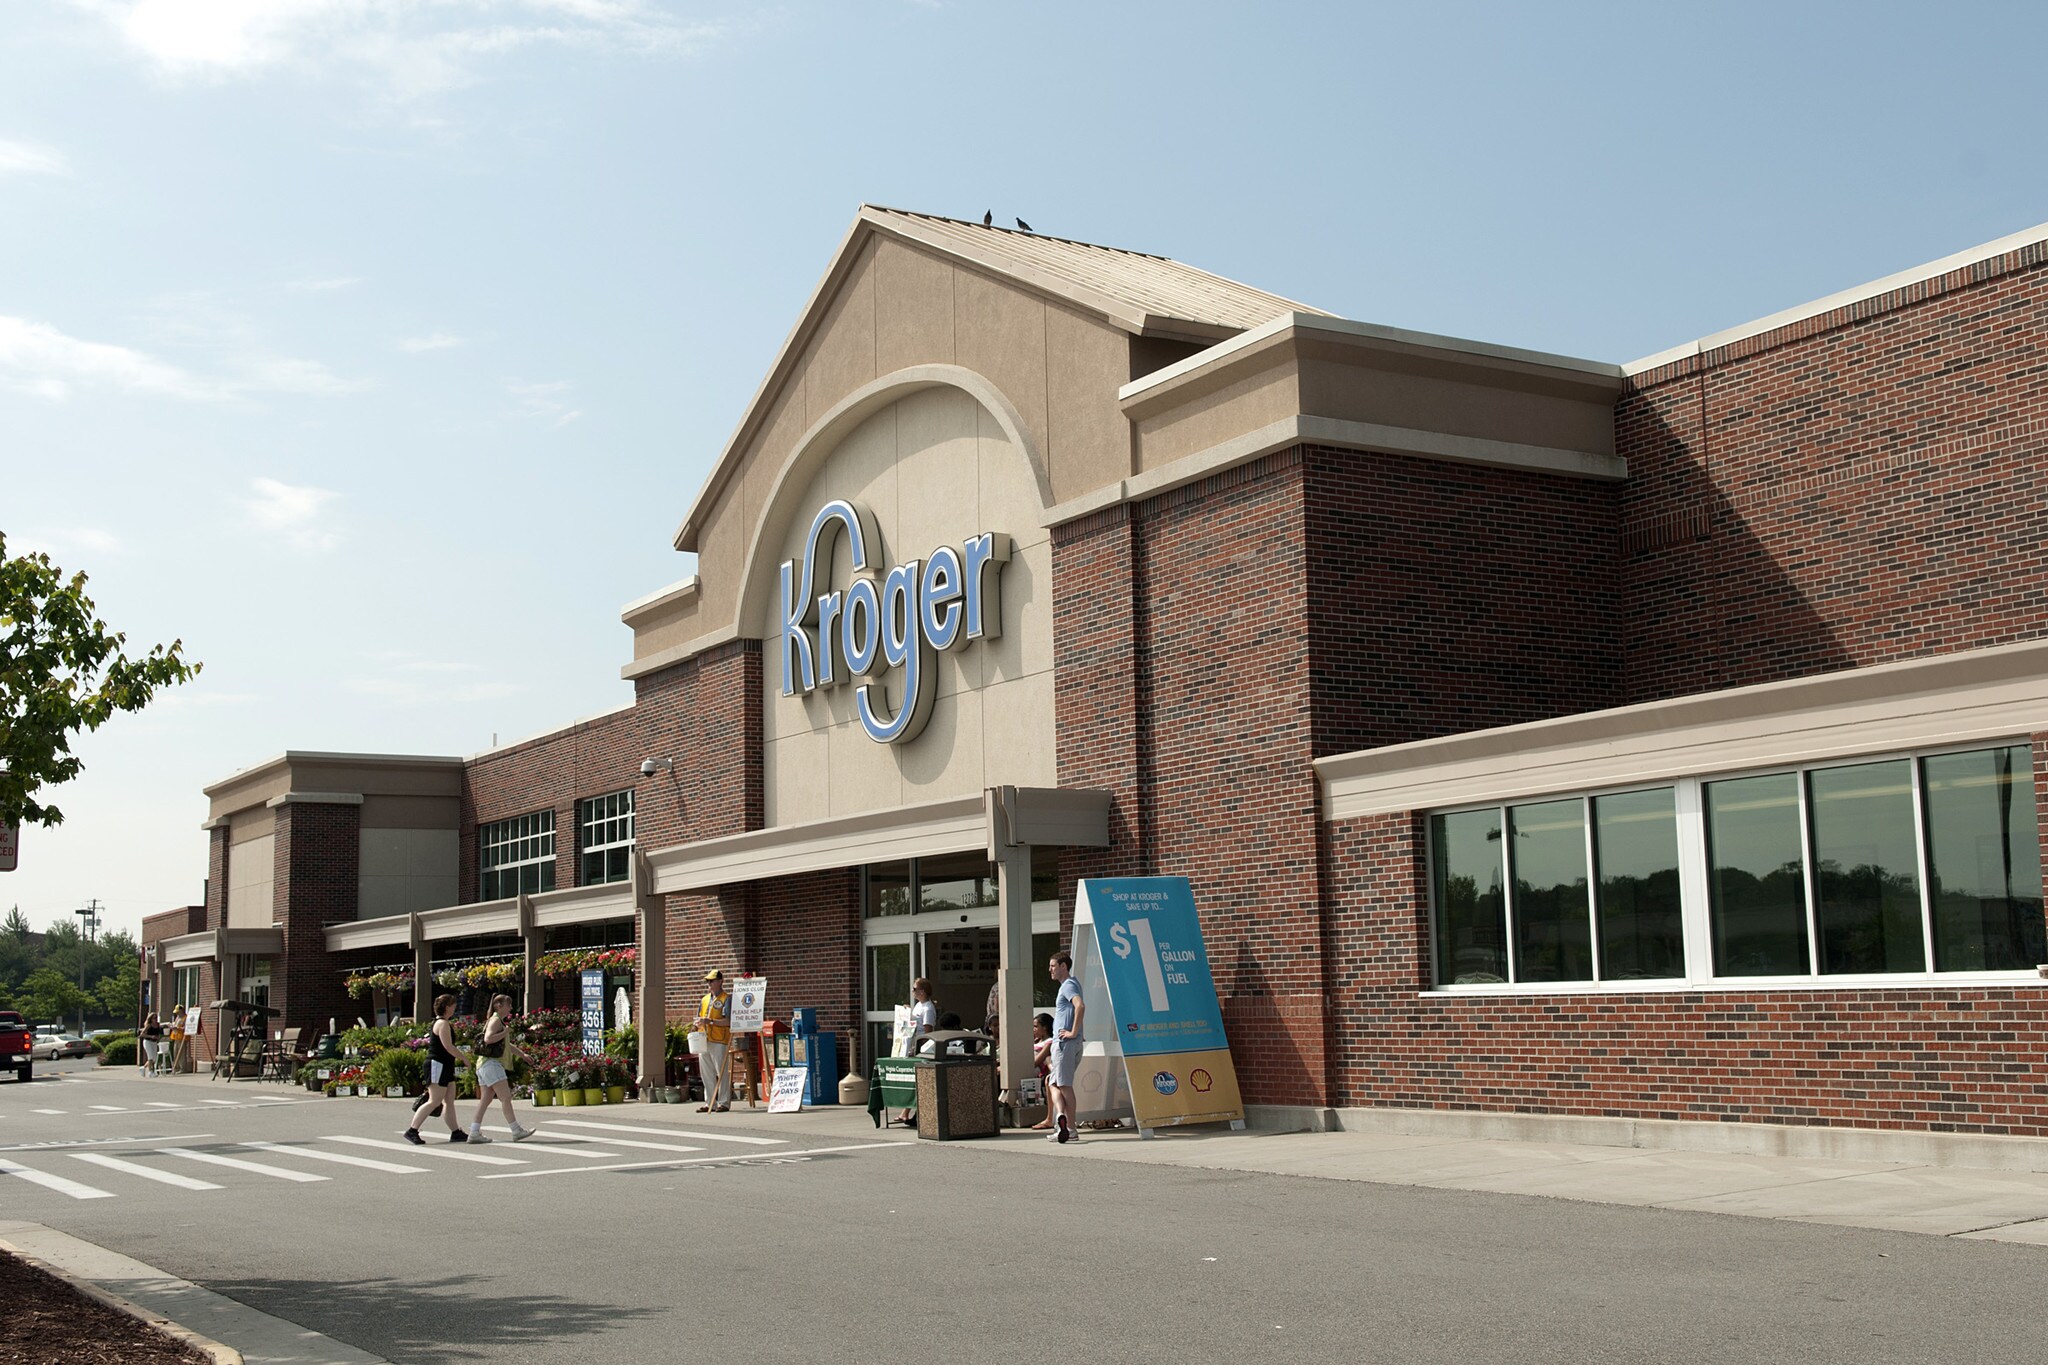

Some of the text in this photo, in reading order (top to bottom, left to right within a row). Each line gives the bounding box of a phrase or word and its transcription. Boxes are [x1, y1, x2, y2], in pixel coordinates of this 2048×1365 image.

[781, 499, 1002, 744] Kroger
[1112, 893, 1129, 901] SHOP
[1138, 892, 1163, 900] KROGER
[1164, 892, 1169, 900] &
[1126, 903, 1141, 911] SAVE
[1141, 903, 1150, 911] UP
[1159, 942, 1170, 950] PER
[1161, 951, 1195, 962] GALLON
[1164, 963, 1174, 971] ON
[1167, 972, 1189, 984] FUEL
